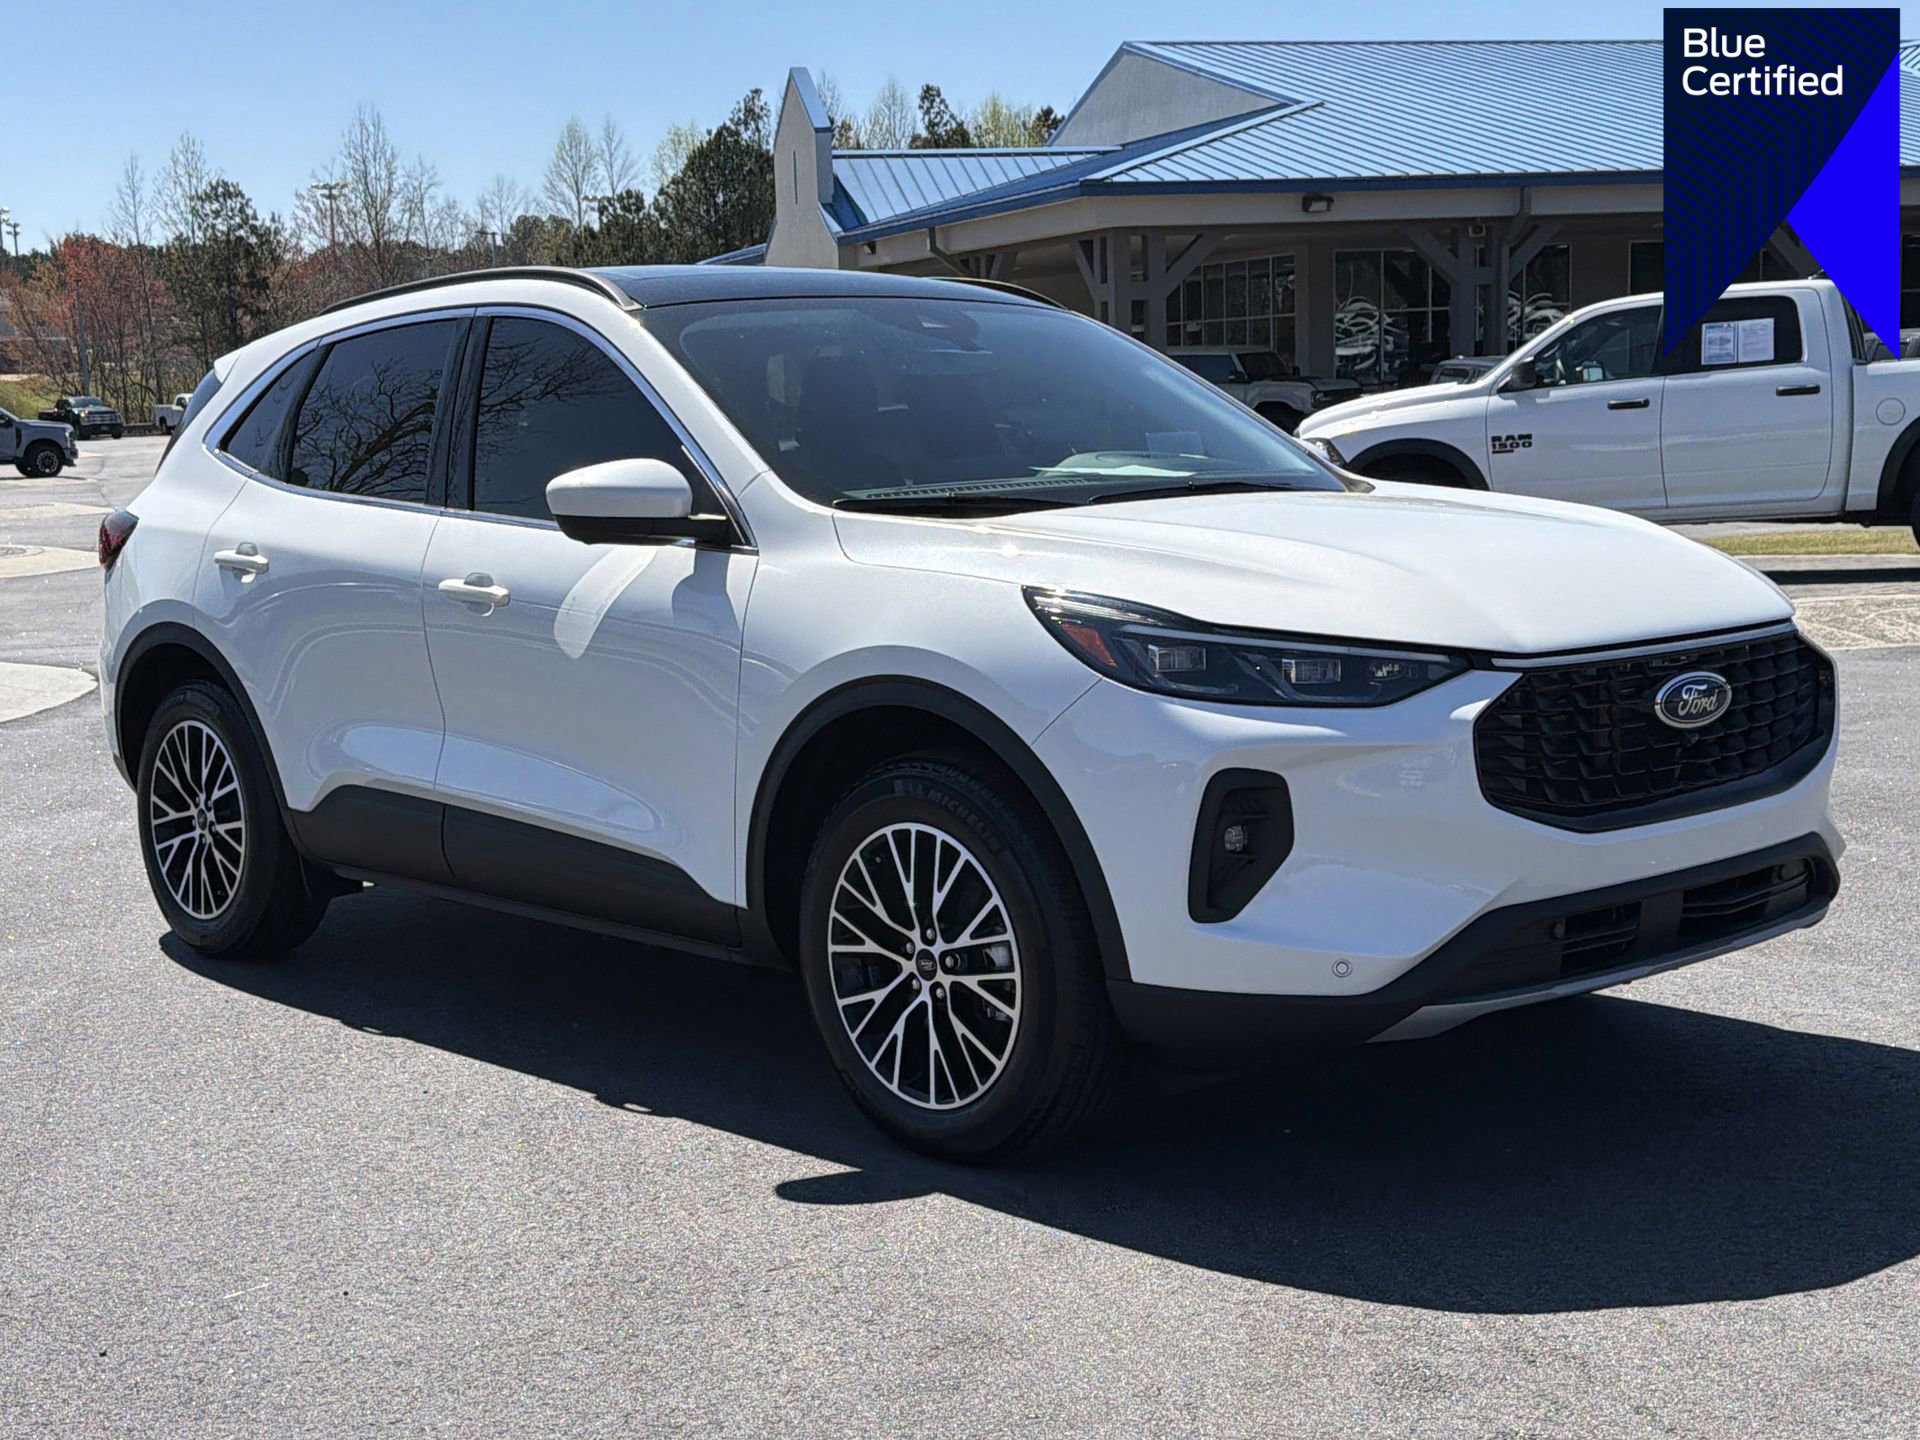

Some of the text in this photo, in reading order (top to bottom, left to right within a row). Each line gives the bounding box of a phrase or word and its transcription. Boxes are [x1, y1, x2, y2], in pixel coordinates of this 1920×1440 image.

[1491, 433, 1533, 442] RAM
[1492, 441, 1533, 450] 1500
[1678, 684, 1719, 716] Ford
